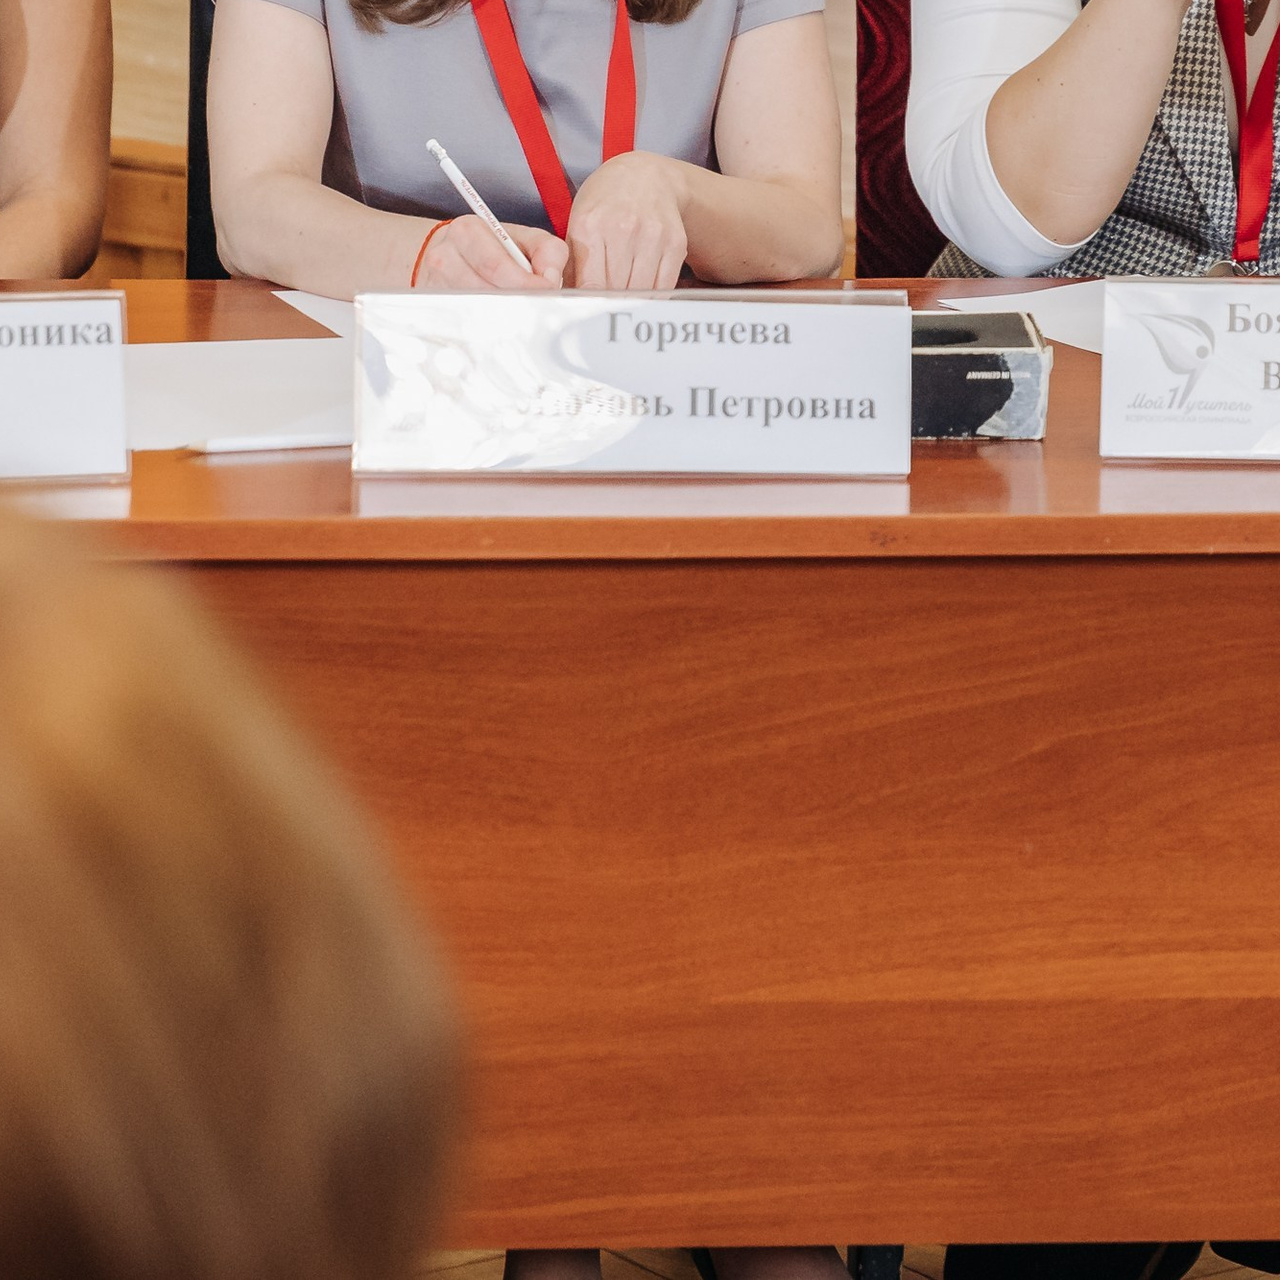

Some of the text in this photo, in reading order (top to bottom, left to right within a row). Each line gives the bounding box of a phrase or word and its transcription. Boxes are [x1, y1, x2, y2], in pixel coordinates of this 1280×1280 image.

[0, 322, 114, 348] оника
[606, 311, 792, 352] Горячева
[688, 386, 878, 427] Петровна
